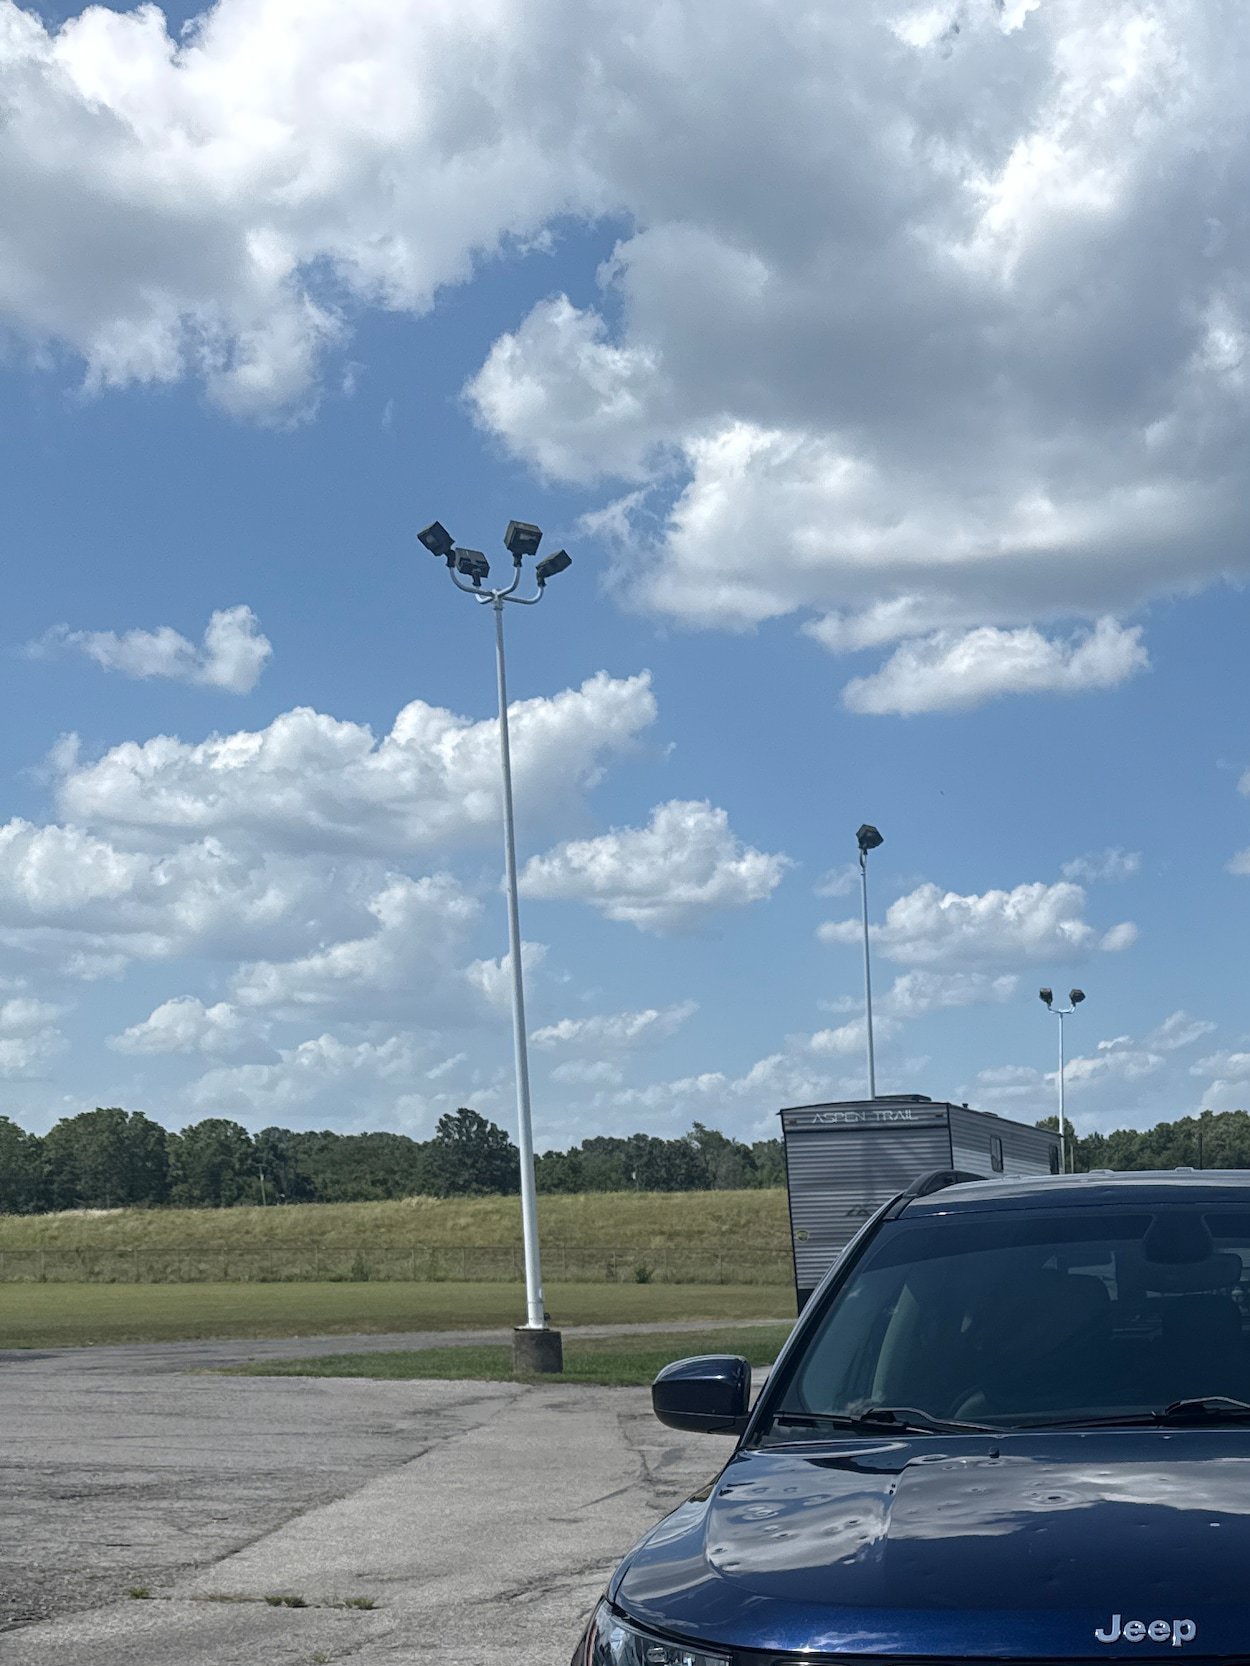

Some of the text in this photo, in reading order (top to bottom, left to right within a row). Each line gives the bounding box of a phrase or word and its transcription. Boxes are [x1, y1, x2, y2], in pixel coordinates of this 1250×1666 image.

[812, 1109, 919, 1124] ASPEN TRAIL
[1095, 1614, 1197, 1647] Jeep
